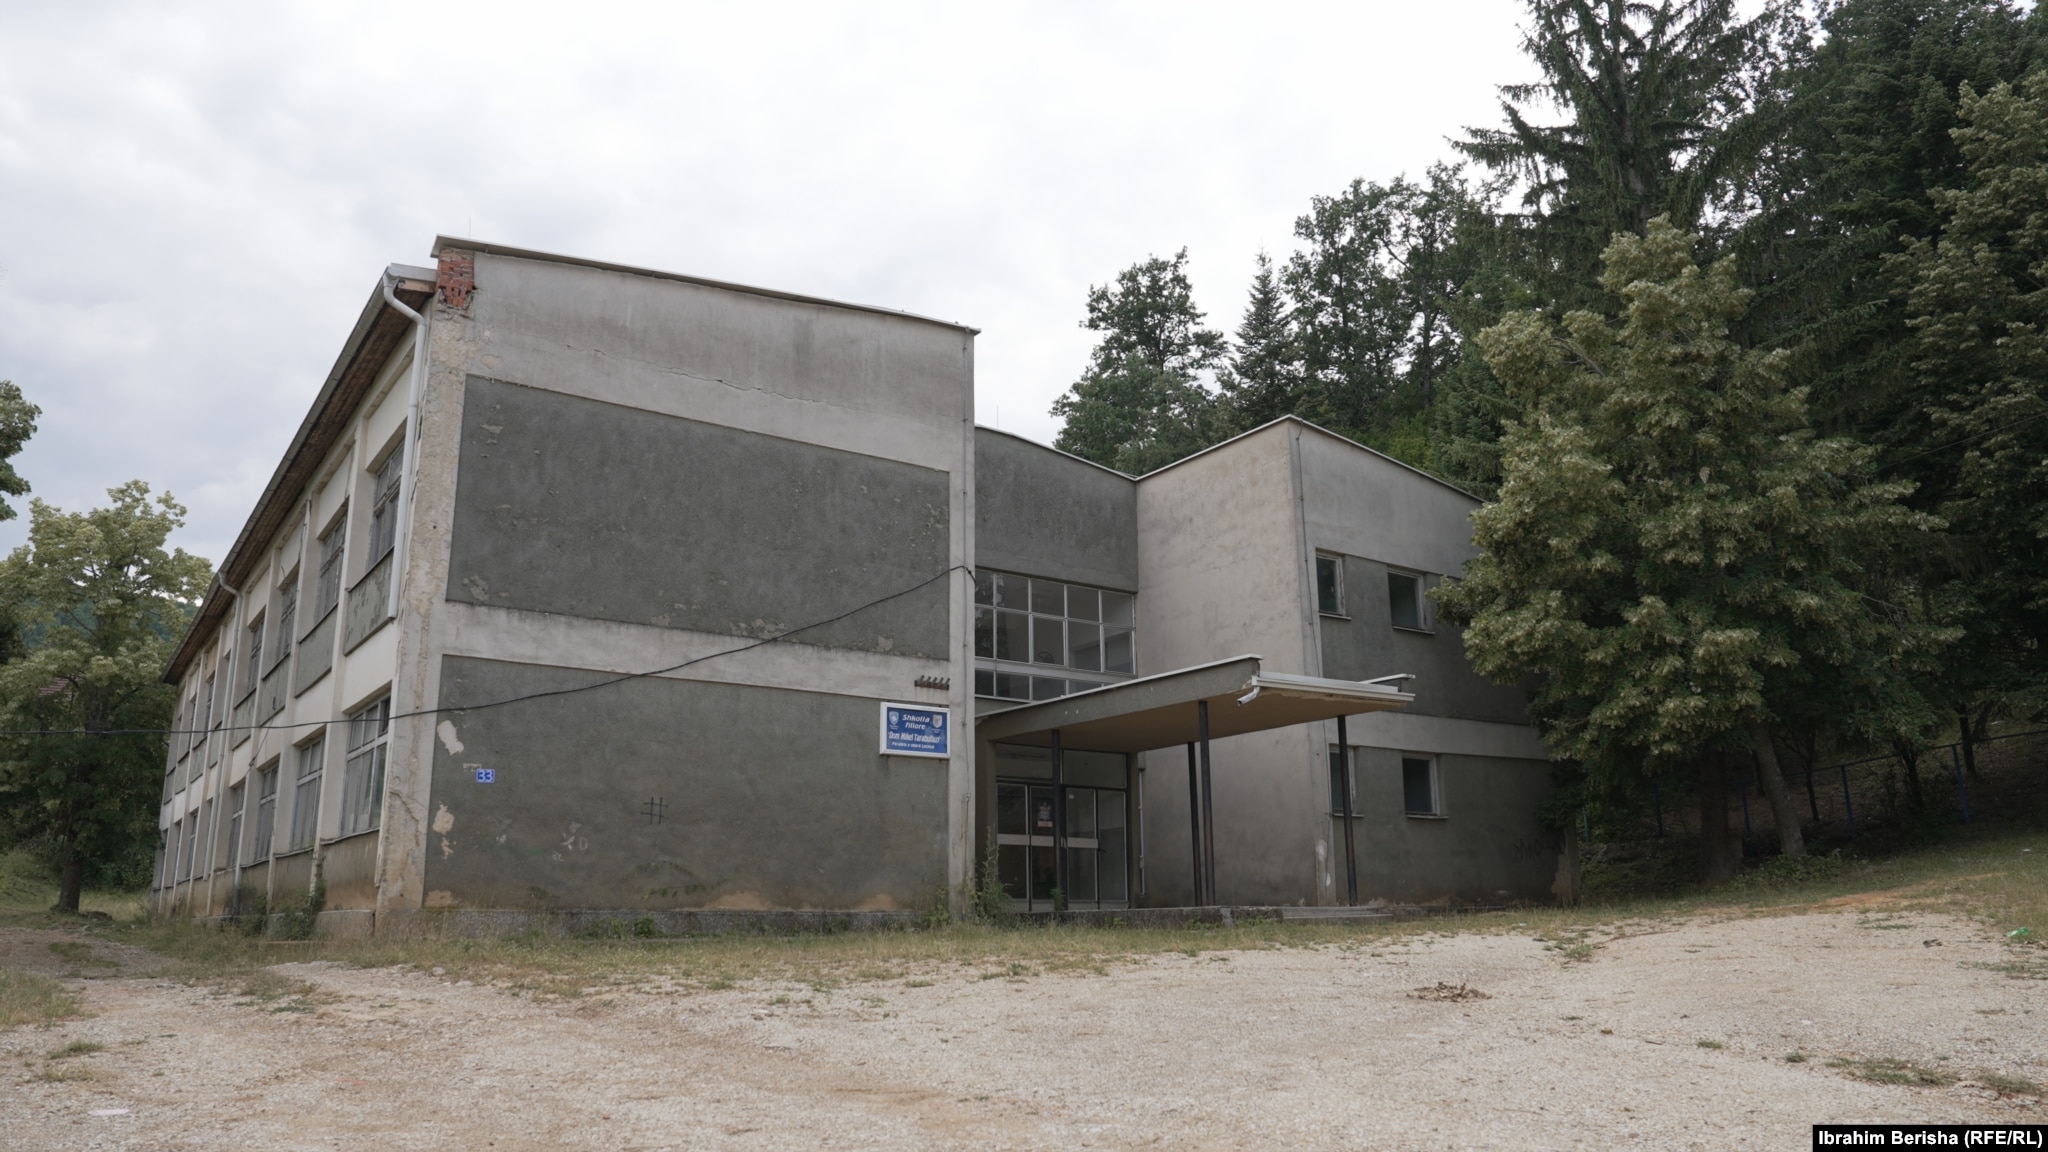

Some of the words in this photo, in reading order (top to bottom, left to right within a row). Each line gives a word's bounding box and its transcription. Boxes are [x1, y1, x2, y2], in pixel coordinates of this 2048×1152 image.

[902, 714, 930, 723] Shkolla
[905, 722, 926, 730] fillore
[478, 770, 493, 782] 33
